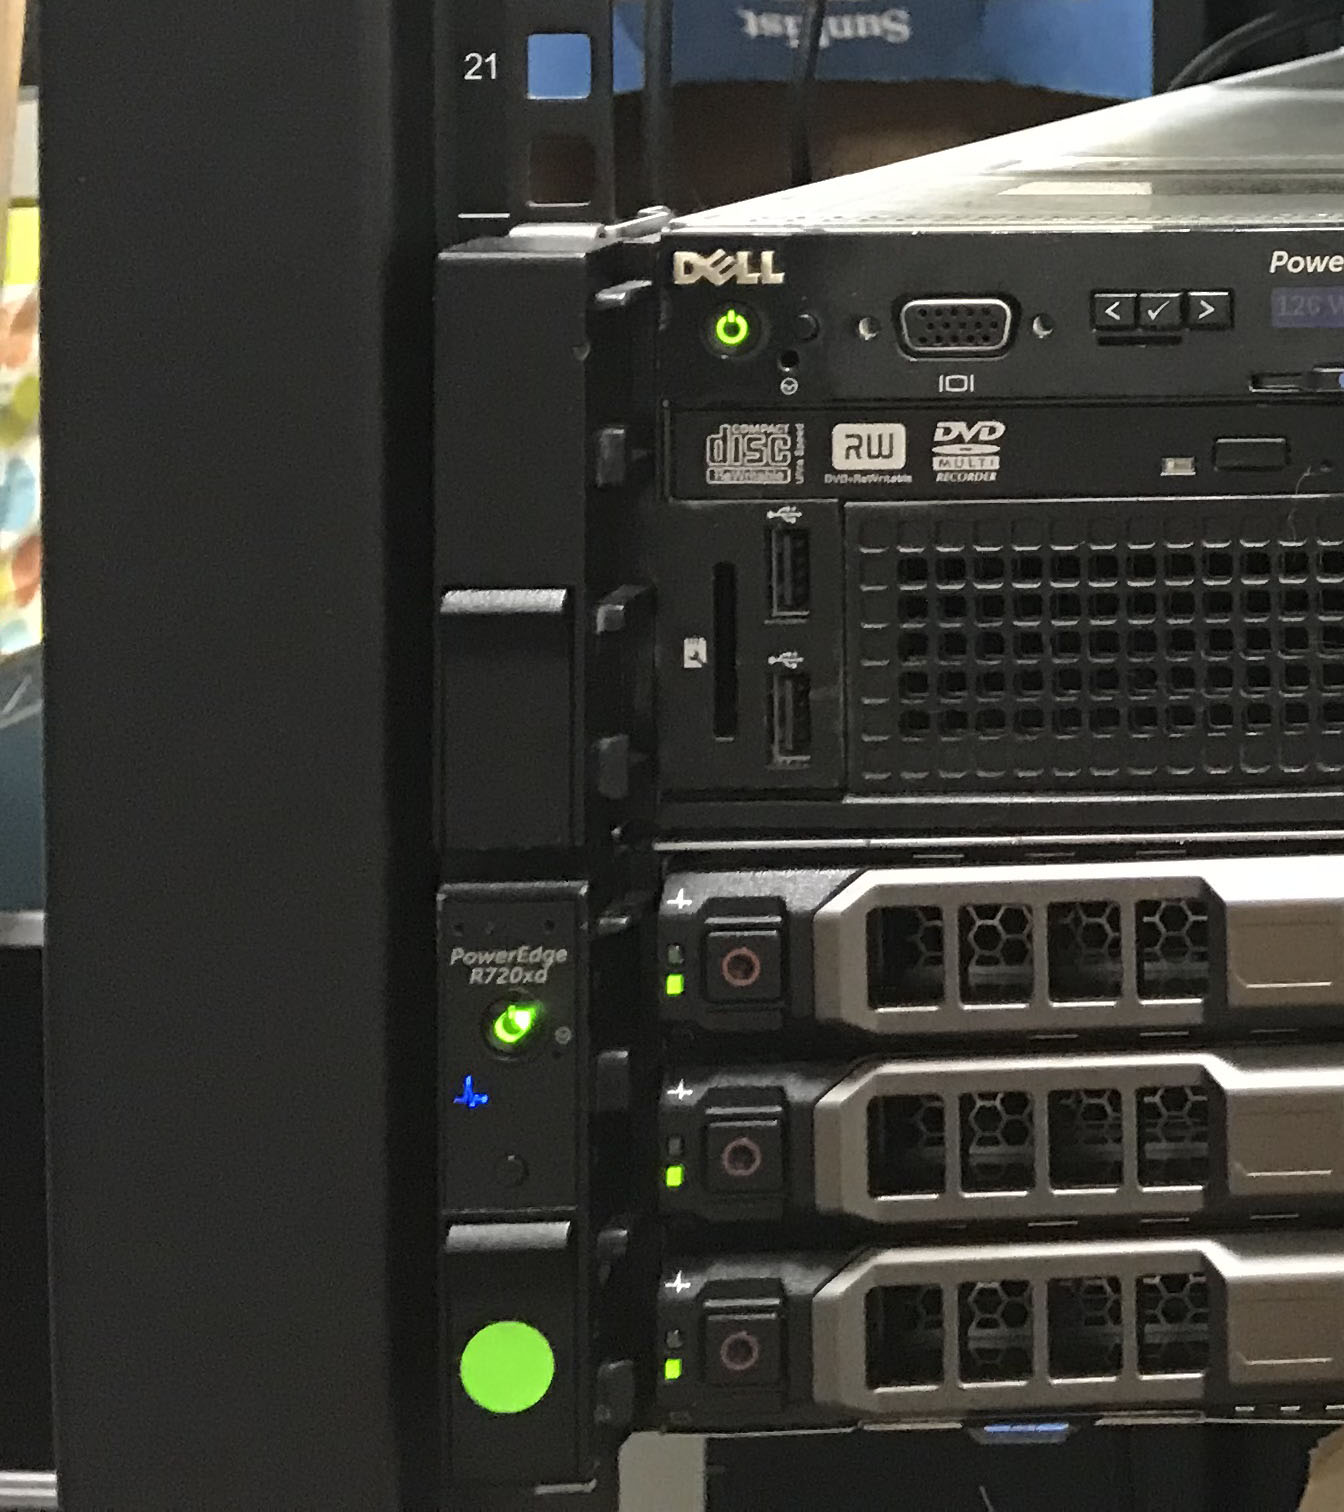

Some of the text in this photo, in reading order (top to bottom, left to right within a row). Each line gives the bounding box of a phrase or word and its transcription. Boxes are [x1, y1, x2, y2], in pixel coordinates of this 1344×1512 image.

[737, 8, 911, 49] Sunist
[464, 52, 497, 80] 21
[673, 249, 785, 286] DELL
[933, 420, 1006, 443] DVD
[706, 424, 792, 466] disc
[844, 433, 894, 460] RW
[938, 457, 995, 468] MULTI
[935, 472, 998, 483] RECORDER
[449, 945, 568, 968] PowerEdge
[469, 966, 548, 984] R720xd
